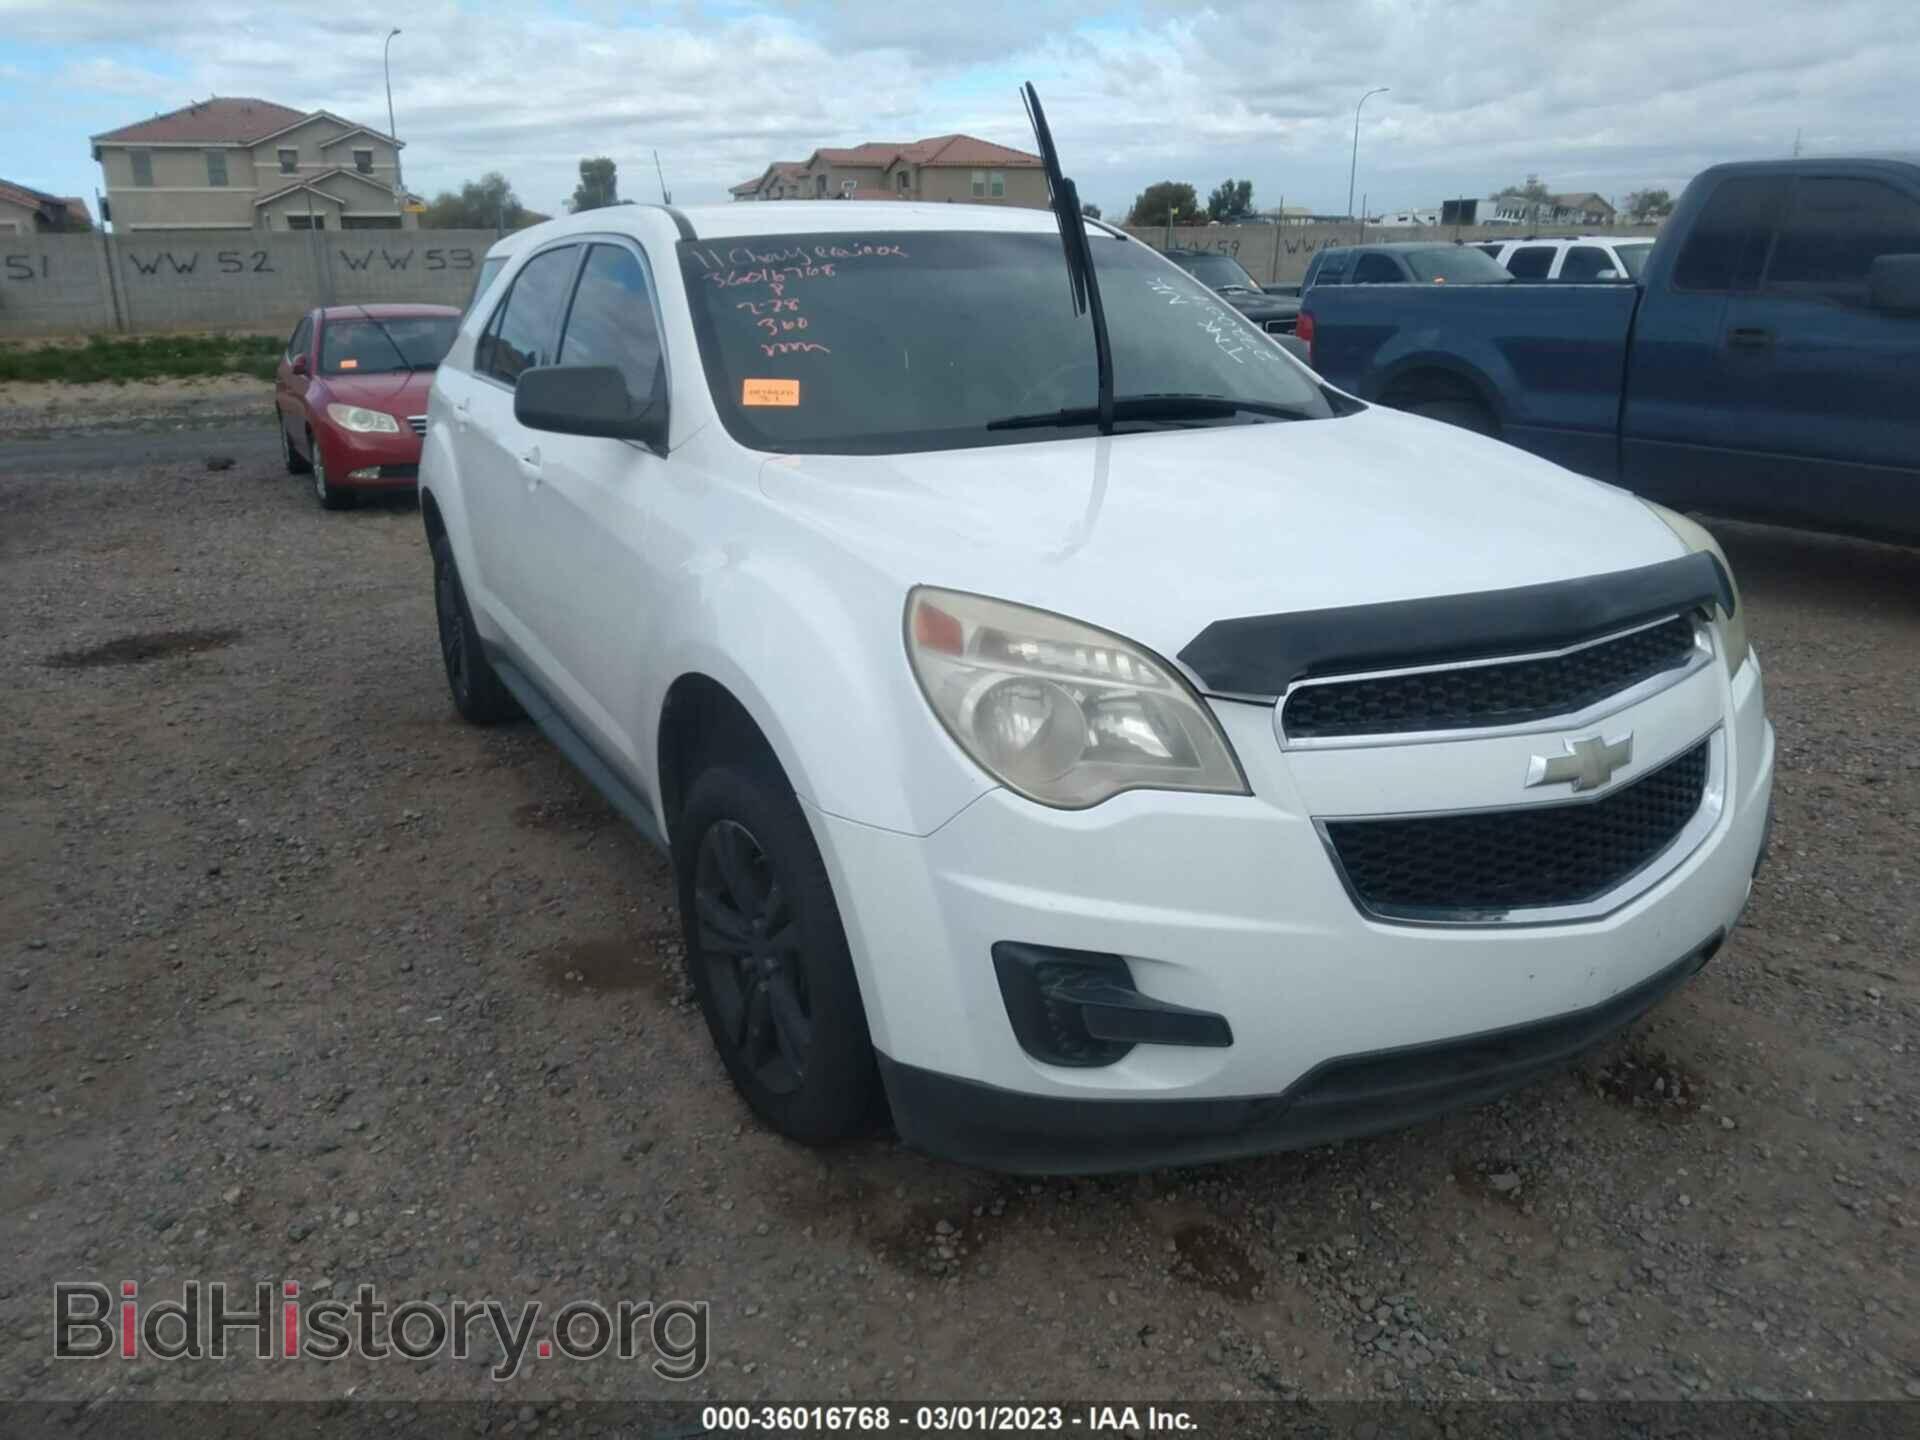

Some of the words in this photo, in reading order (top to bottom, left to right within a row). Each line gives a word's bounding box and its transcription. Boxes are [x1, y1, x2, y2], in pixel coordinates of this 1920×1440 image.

[5, 254, 49, 280] 51
[128, 251, 198, 274] WW
[217, 251, 276, 274] 52
[339, 248, 415, 271] WW
[424, 248, 475, 271] 53
